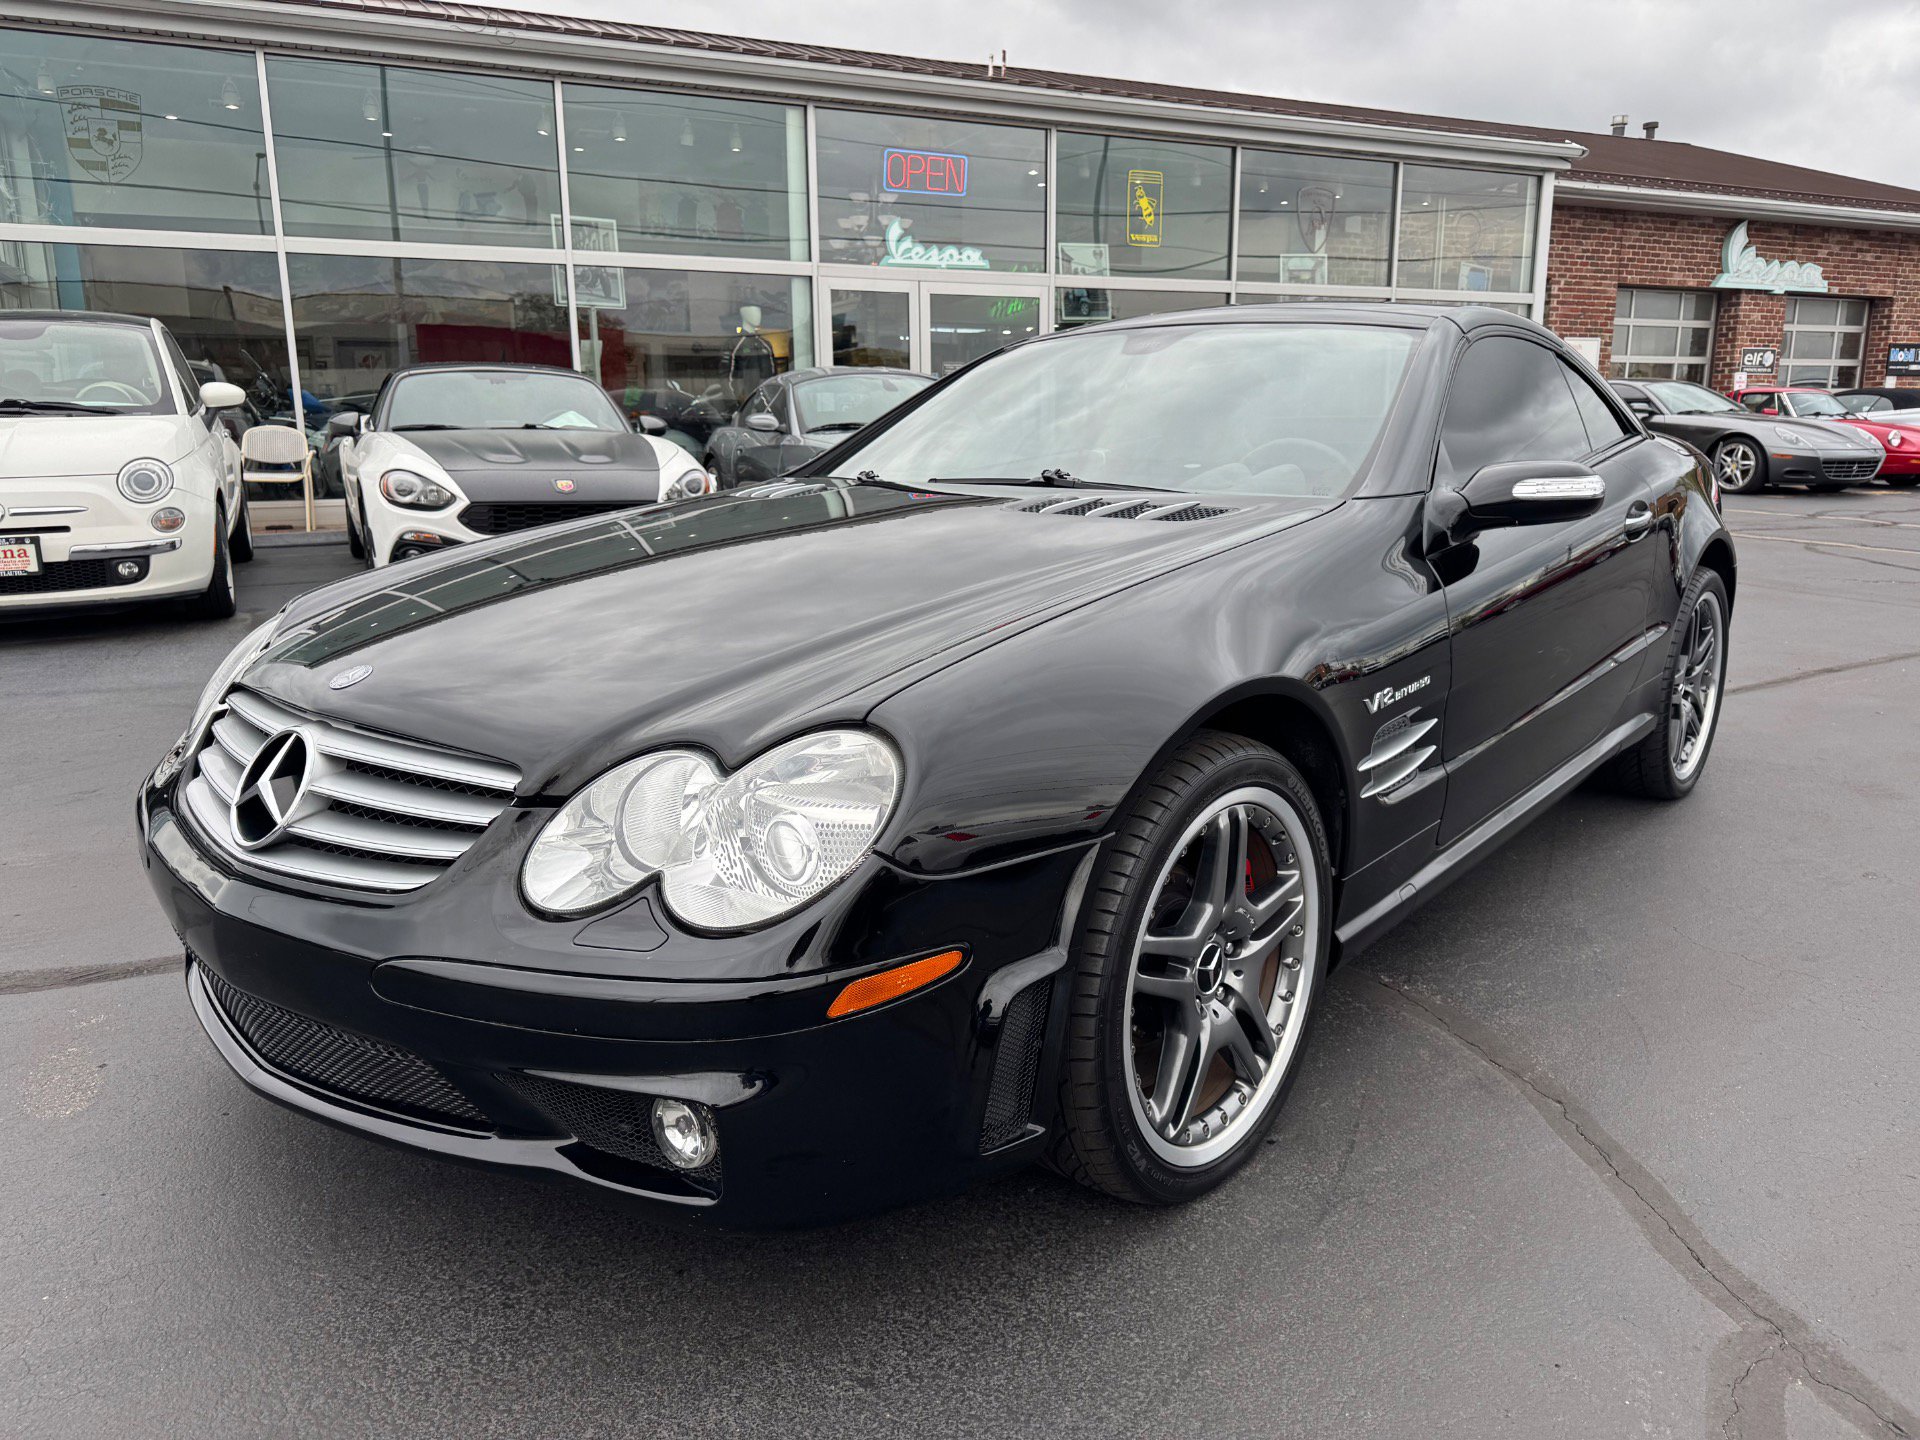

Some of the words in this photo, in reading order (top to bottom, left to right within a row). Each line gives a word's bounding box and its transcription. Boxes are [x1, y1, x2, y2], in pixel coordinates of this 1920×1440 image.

[60, 88, 139, 104] PORSCHE
[887, 153, 965, 193] OPEN
[884, 217, 989, 268] Vespa
[1715, 220, 1828, 294] Vespa
[1744, 352, 1763, 366] elf
[0, 548, 30, 559] na
[1362, 687, 1395, 715] V12
[1395, 675, 1431, 701] BITURBO
